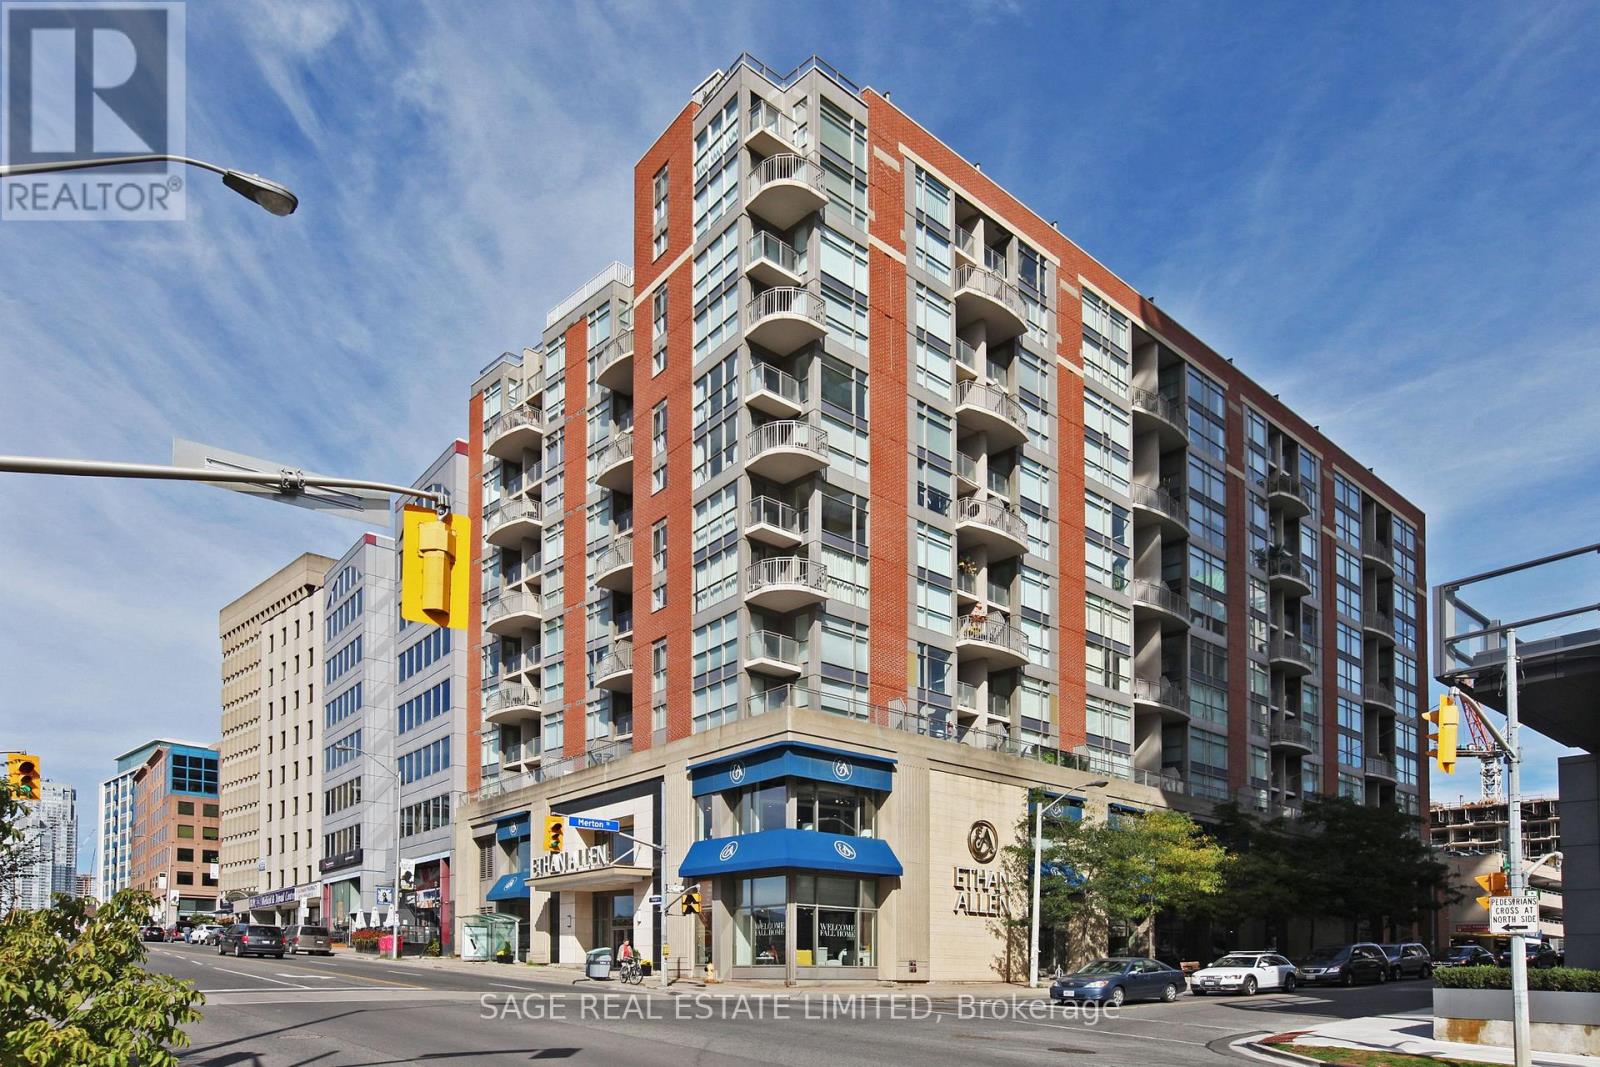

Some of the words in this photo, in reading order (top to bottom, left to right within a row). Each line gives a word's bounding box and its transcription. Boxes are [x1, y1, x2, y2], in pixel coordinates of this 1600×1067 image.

[578, 819, 604, 828] Merton
[532, 852, 569, 878] ETHAN
[568, 845, 609, 873] ALLEN
[954, 866, 1011, 895] ETHAN
[954, 890, 1012, 918] ALLEN
[1491, 898, 1537, 906] PEDESTRIANS
[755, 921, 785, 930] WELCOME
[820, 922, 856, 931] WELCOME
[820, 929, 835, 937] FALL
[837, 930, 856, 938] HOME
